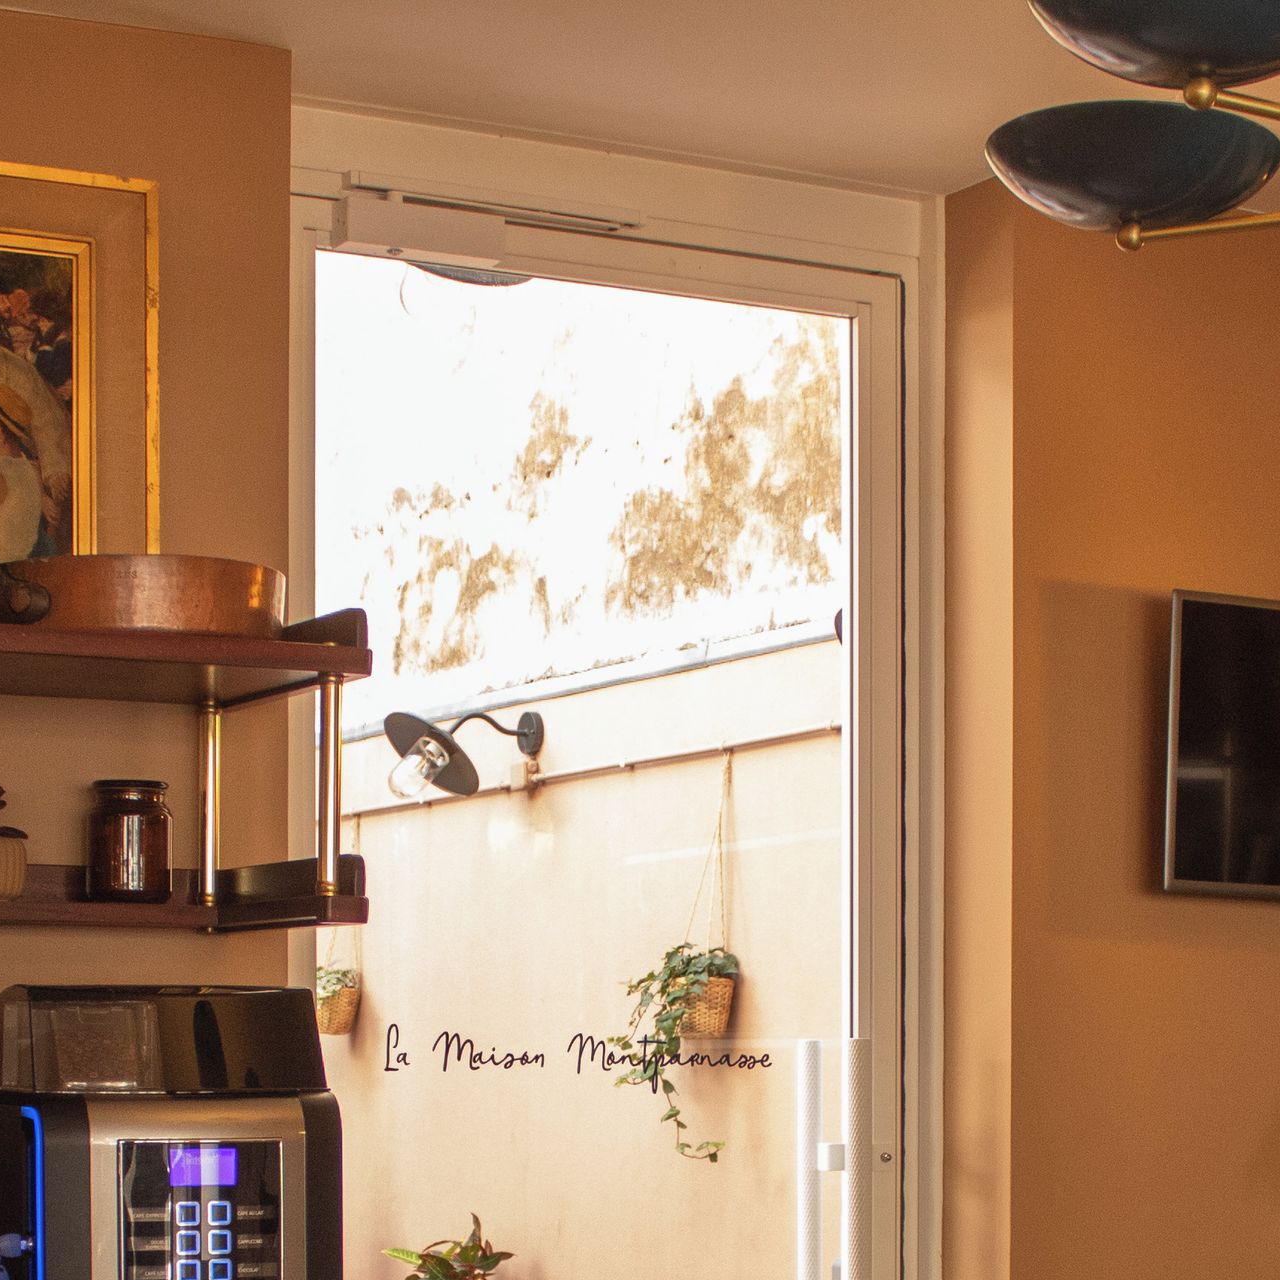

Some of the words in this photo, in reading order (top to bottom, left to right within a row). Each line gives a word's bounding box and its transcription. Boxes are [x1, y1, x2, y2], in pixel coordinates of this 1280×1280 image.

[384, 1023, 410, 1072] La
[432, 1031, 545, 1072] Maison
[567, 1033, 773, 1094] Montparnasse
